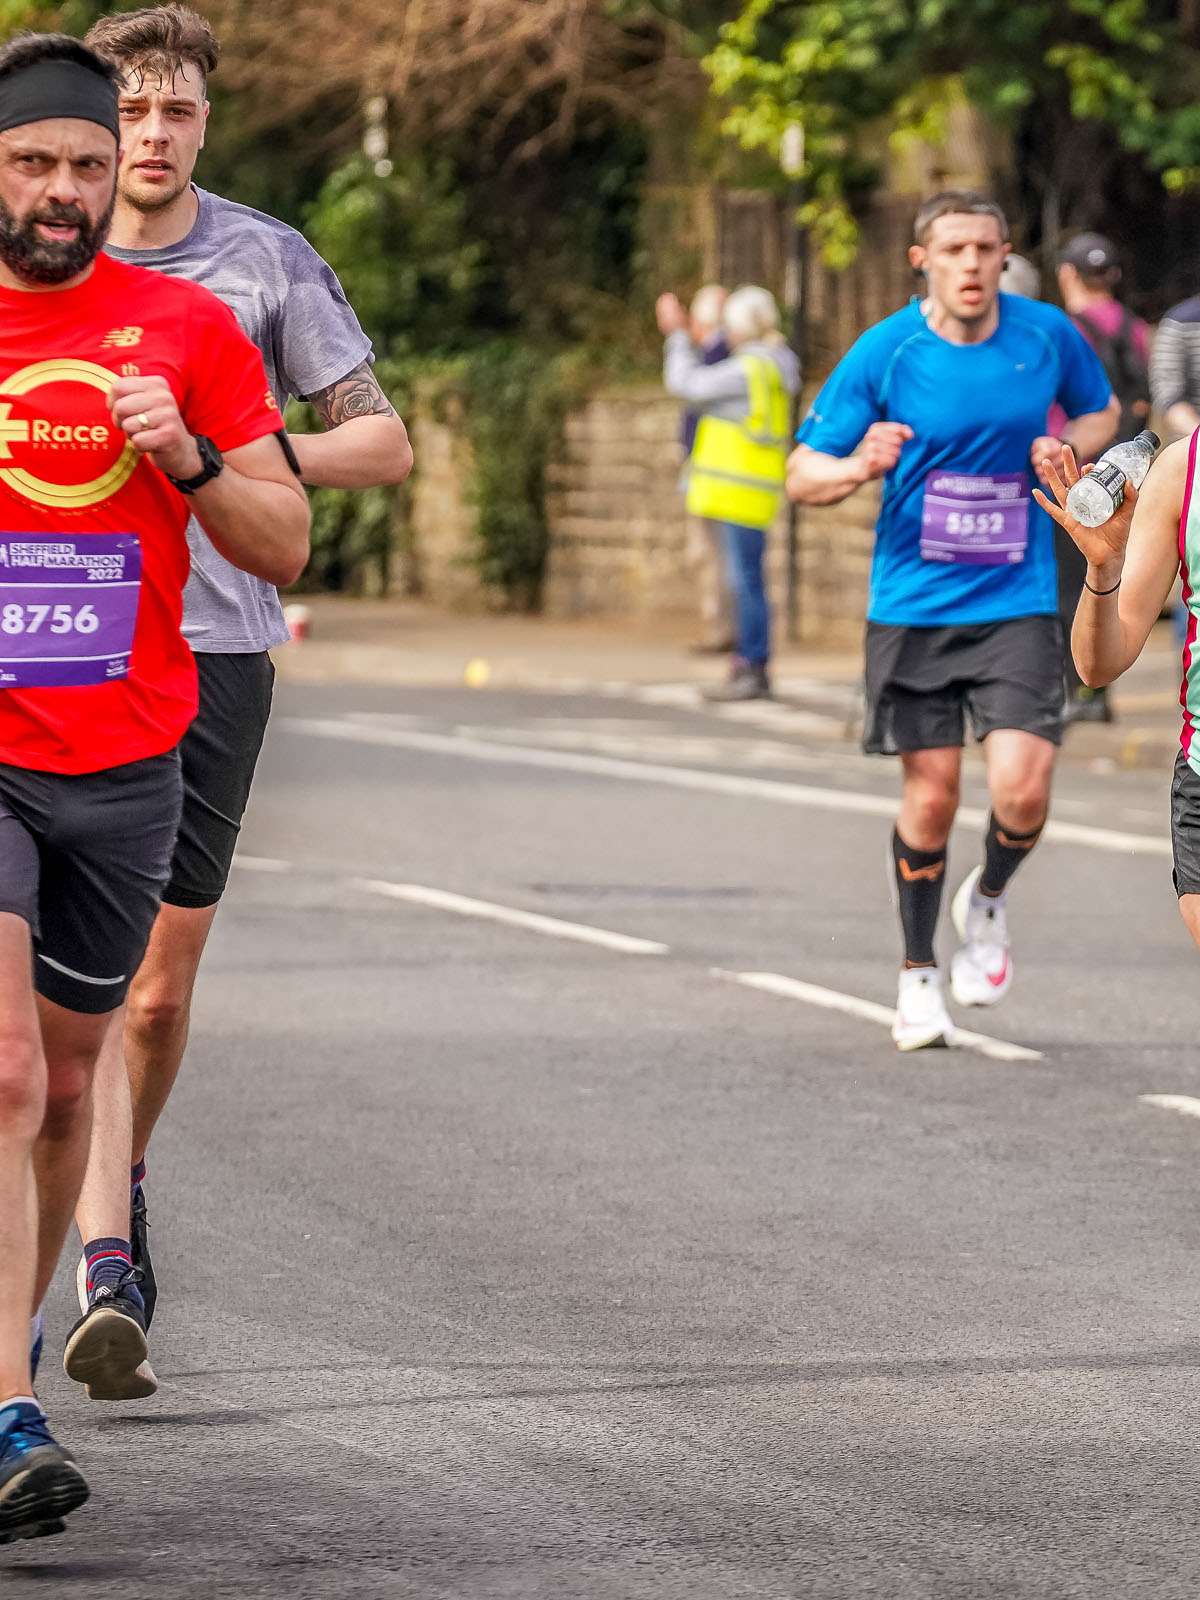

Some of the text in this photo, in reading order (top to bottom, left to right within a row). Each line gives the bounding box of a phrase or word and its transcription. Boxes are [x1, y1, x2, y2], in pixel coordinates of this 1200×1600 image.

[121, 362, 140, 376] th
[33, 419, 109, 442] Race
[11, 543, 73, 554] SHEFFIELD
[11, 555, 123, 567] HALF MARATHON
[87, 568, 123, 580] 2022
[1, 604, 99, 634] 8756
